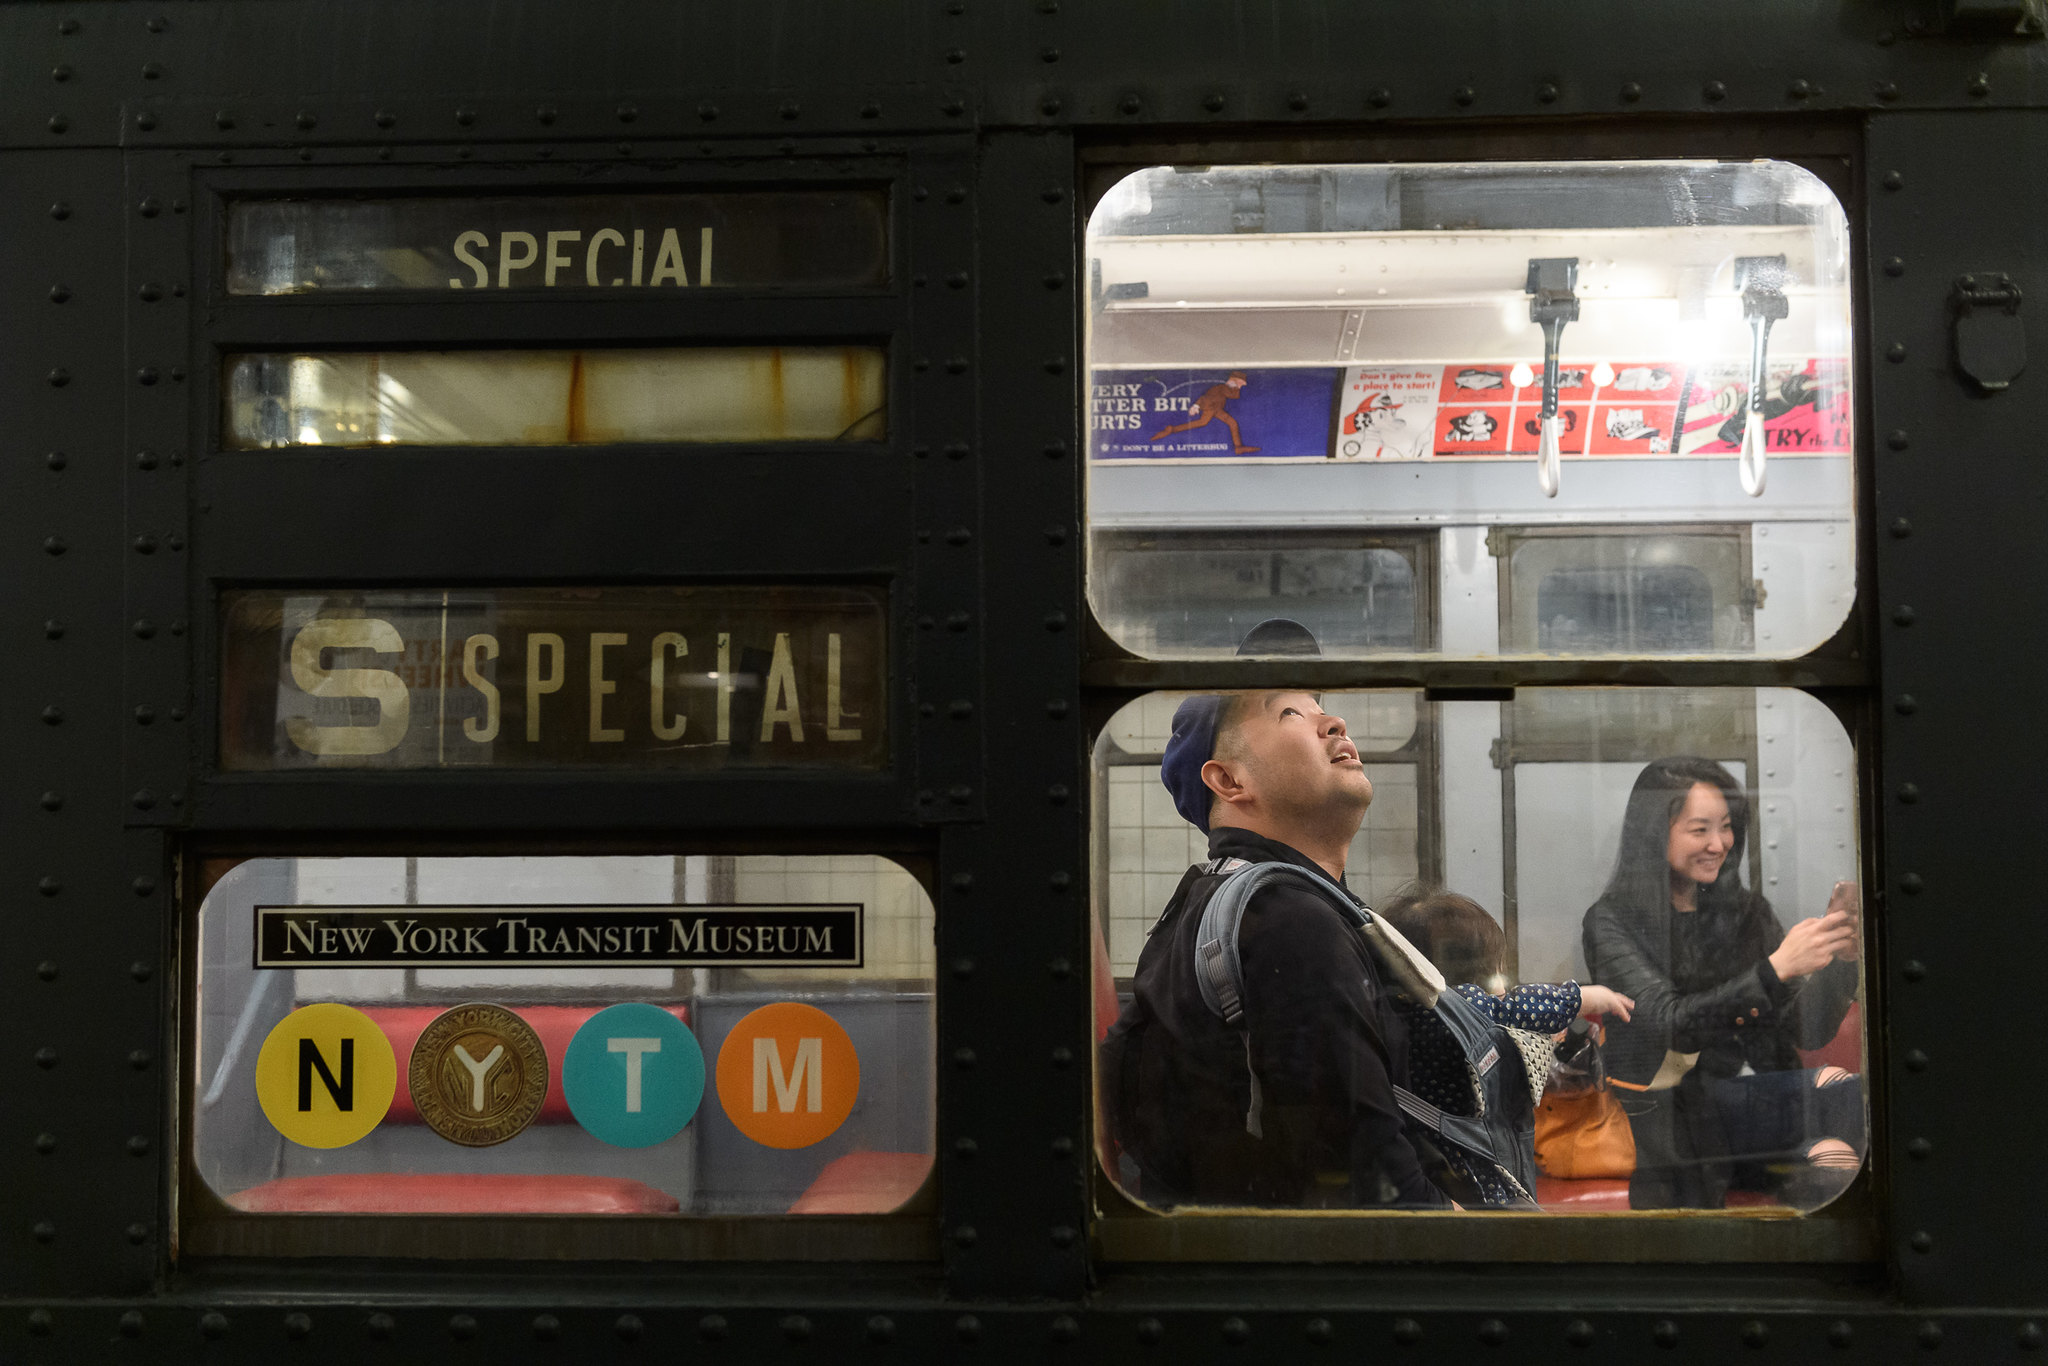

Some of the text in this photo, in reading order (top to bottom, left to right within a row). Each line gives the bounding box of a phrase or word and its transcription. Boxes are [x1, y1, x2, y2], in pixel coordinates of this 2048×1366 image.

[1360, 371, 1433, 381] Don't give fire
[1363, 381, 1390, 392] place
[1393, 381, 1403, 390] to
[1407, 380, 1436, 390] start!
[1155, 396, 1191, 412] BIT
[1152, 443, 1163, 452] BE
[1167, 443, 1175, 452] A
[1177, 442, 1229, 452] LITTERBUG
[285, 618, 411, 756] S
[462, 632, 864, 744] SPECIAL
[284, 917, 835, 955] NEW YORK TRANSIT MUSEUM
[298, 1038, 355, 1113] N
[606, 1038, 662, 1113] T
[752, 1038, 823, 1113] M
